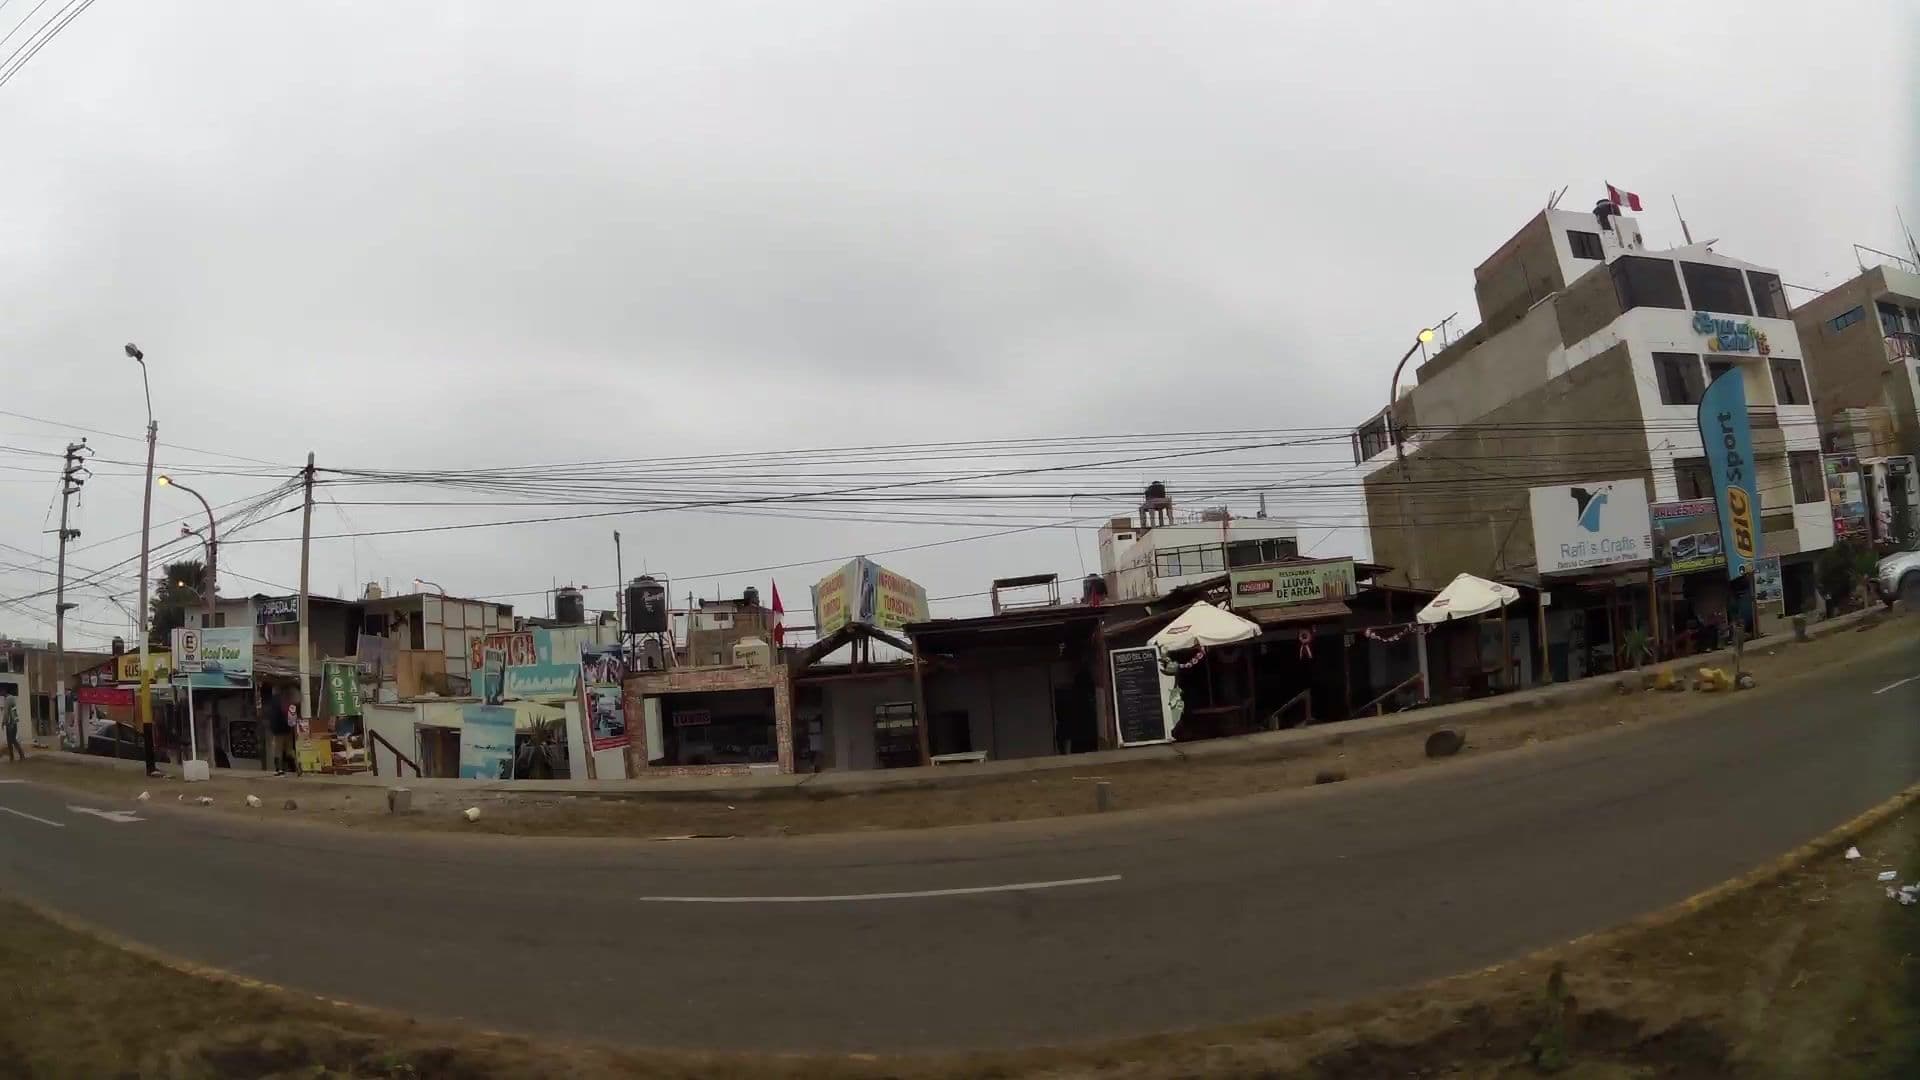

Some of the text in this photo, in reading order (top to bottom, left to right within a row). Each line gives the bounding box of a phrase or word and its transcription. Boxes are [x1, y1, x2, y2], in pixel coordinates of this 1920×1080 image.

[1282, 577, 1314, 588] LLUVIA
[1276, 586, 1321, 598] DE ARENA
